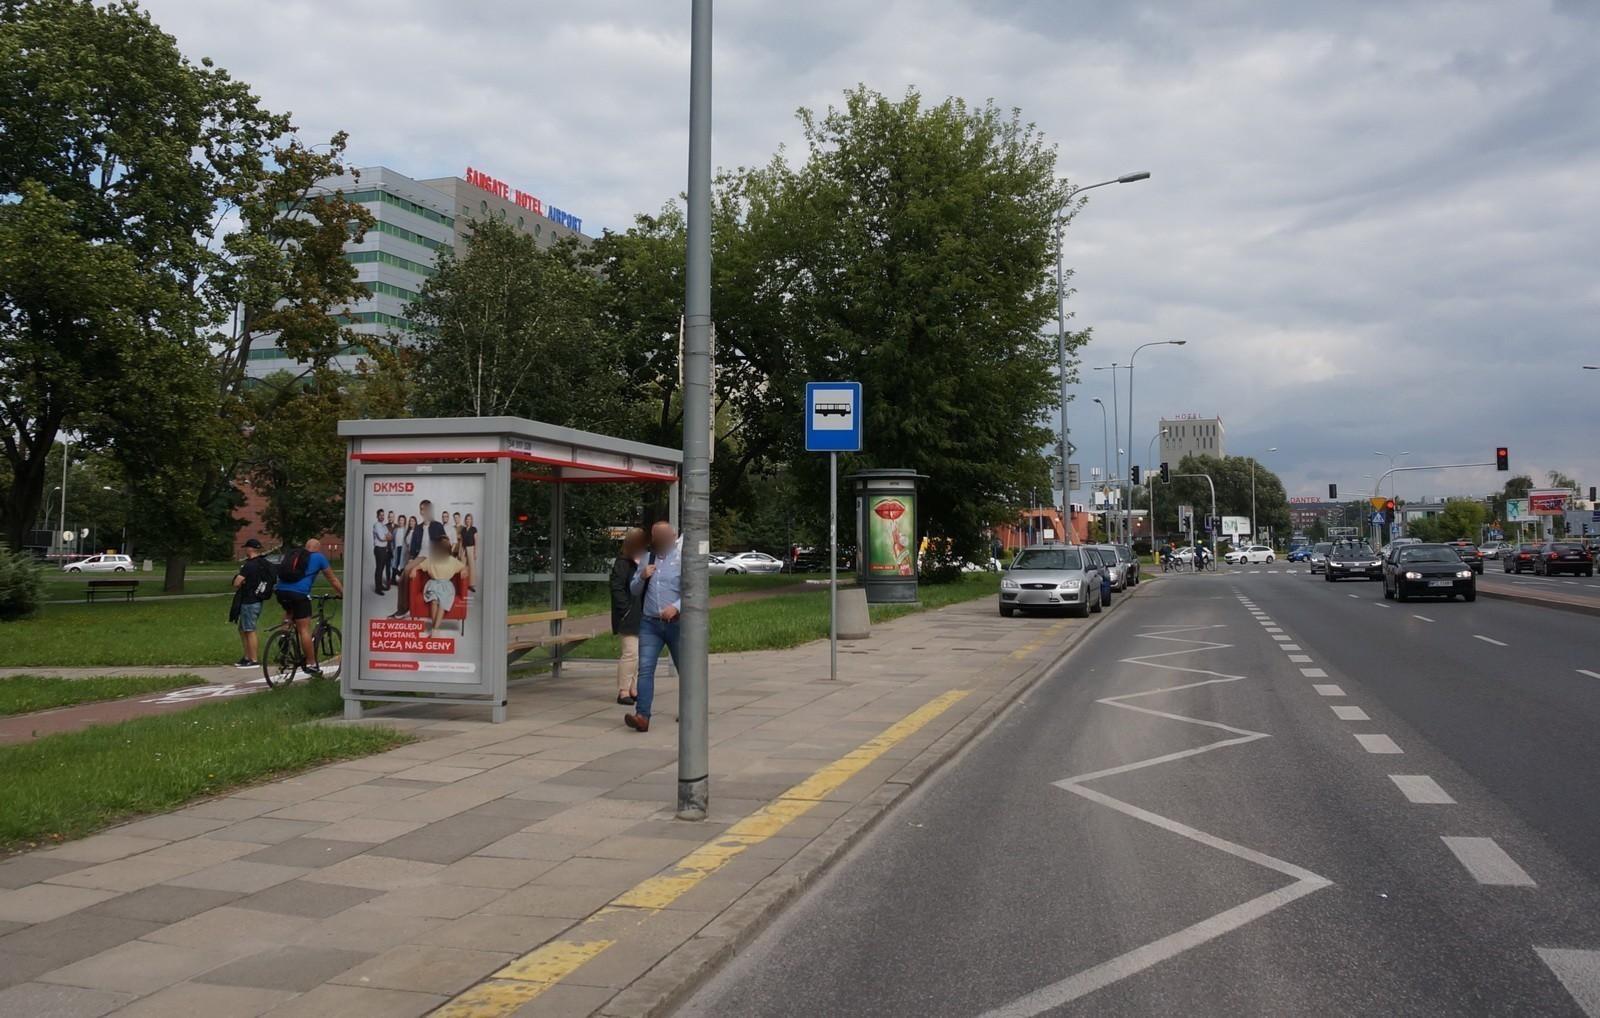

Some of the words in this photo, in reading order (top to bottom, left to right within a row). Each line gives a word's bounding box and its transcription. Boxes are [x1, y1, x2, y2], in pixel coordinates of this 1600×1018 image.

[515, 189, 543, 216] HOTEL
[547, 205, 582, 233] AIRPORT
[373, 482, 405, 492] DKMS
[387, 623, 423, 631] WZGLĘDU
[372, 640, 403, 651] ŁĄCZĄ
[404, 641, 423, 649] NAS
[425, 641, 451, 650] GENY
